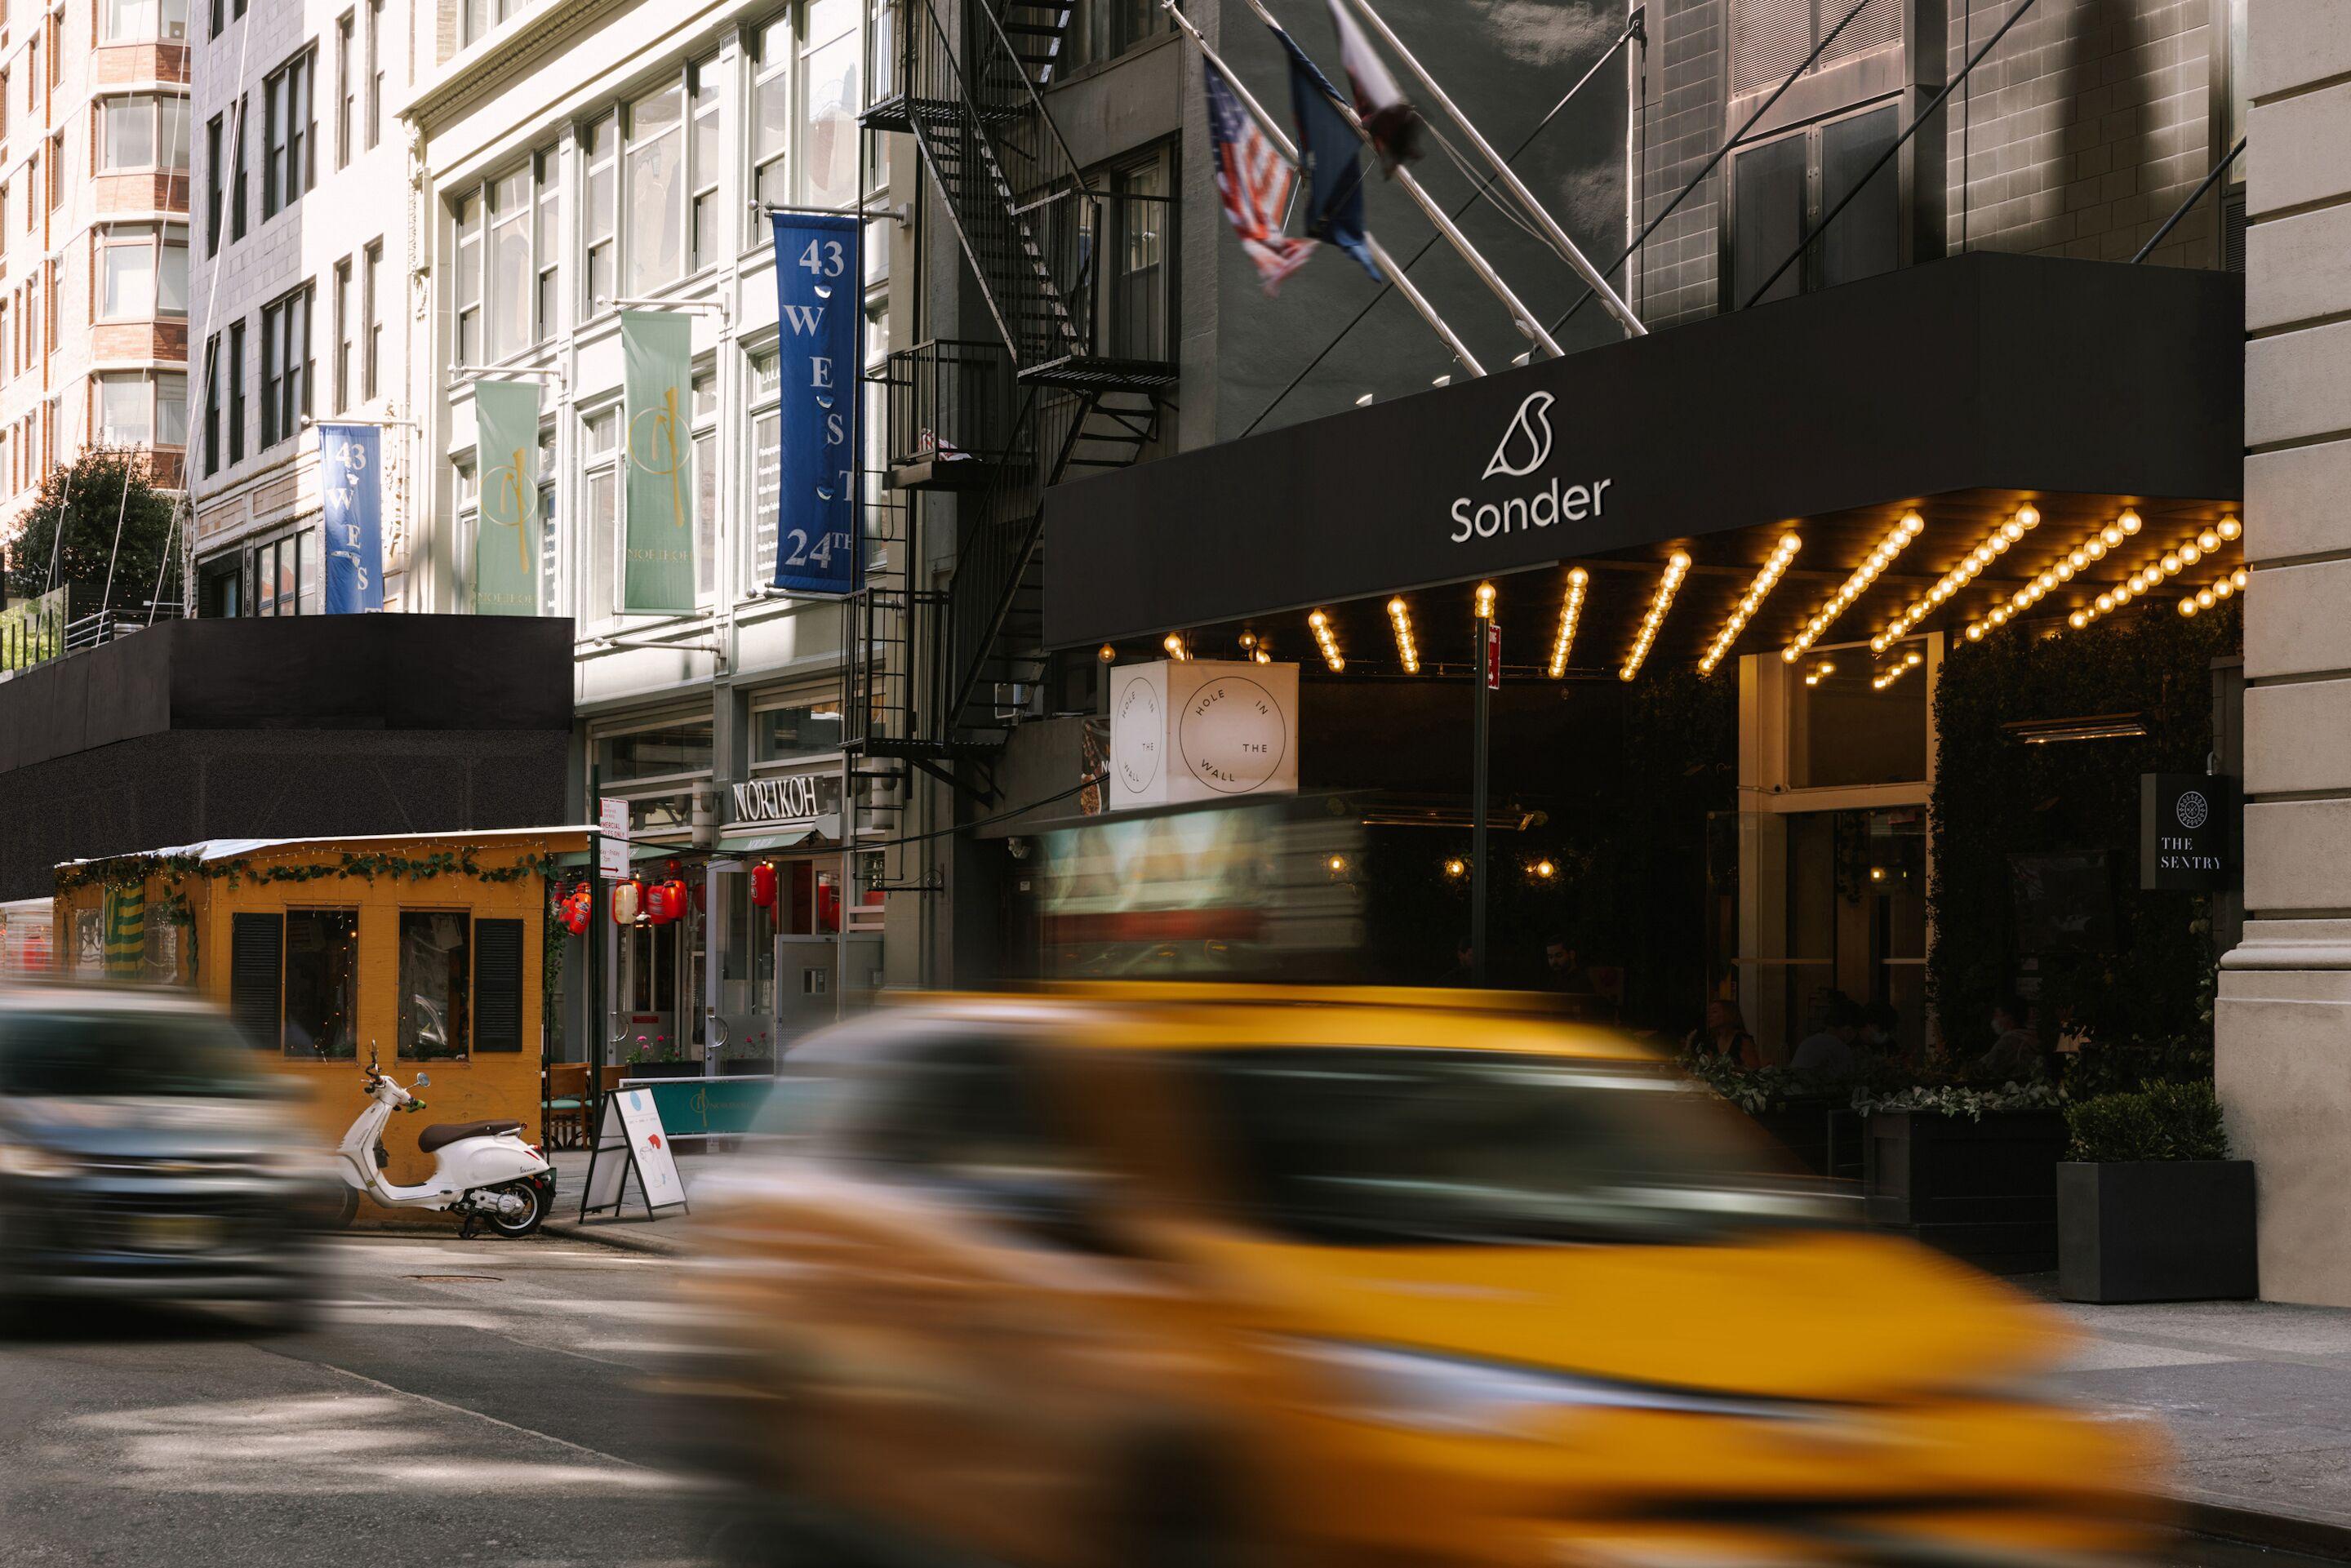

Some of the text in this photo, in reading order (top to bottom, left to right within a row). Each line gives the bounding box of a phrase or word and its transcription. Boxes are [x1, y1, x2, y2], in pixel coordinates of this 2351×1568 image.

[799, 239, 844, 277] 43
[336, 442, 367, 469] 43
[1451, 477, 1612, 544] Sonder
[327, 488, 382, 613] WES
[1122, 691, 1136, 718] HOLE
[1196, 690, 1269, 716] HOLE IN
[1143, 741, 1154, 751] THE
[1242, 744, 1267, 753] THE
[1125, 762, 1140, 782] WALL
[1202, 758, 1236, 782] WALL
[732, 776, 820, 821] NORIKOH
[2161, 837, 2193, 851] THE
[2161, 855, 2221, 870] SENTRY
